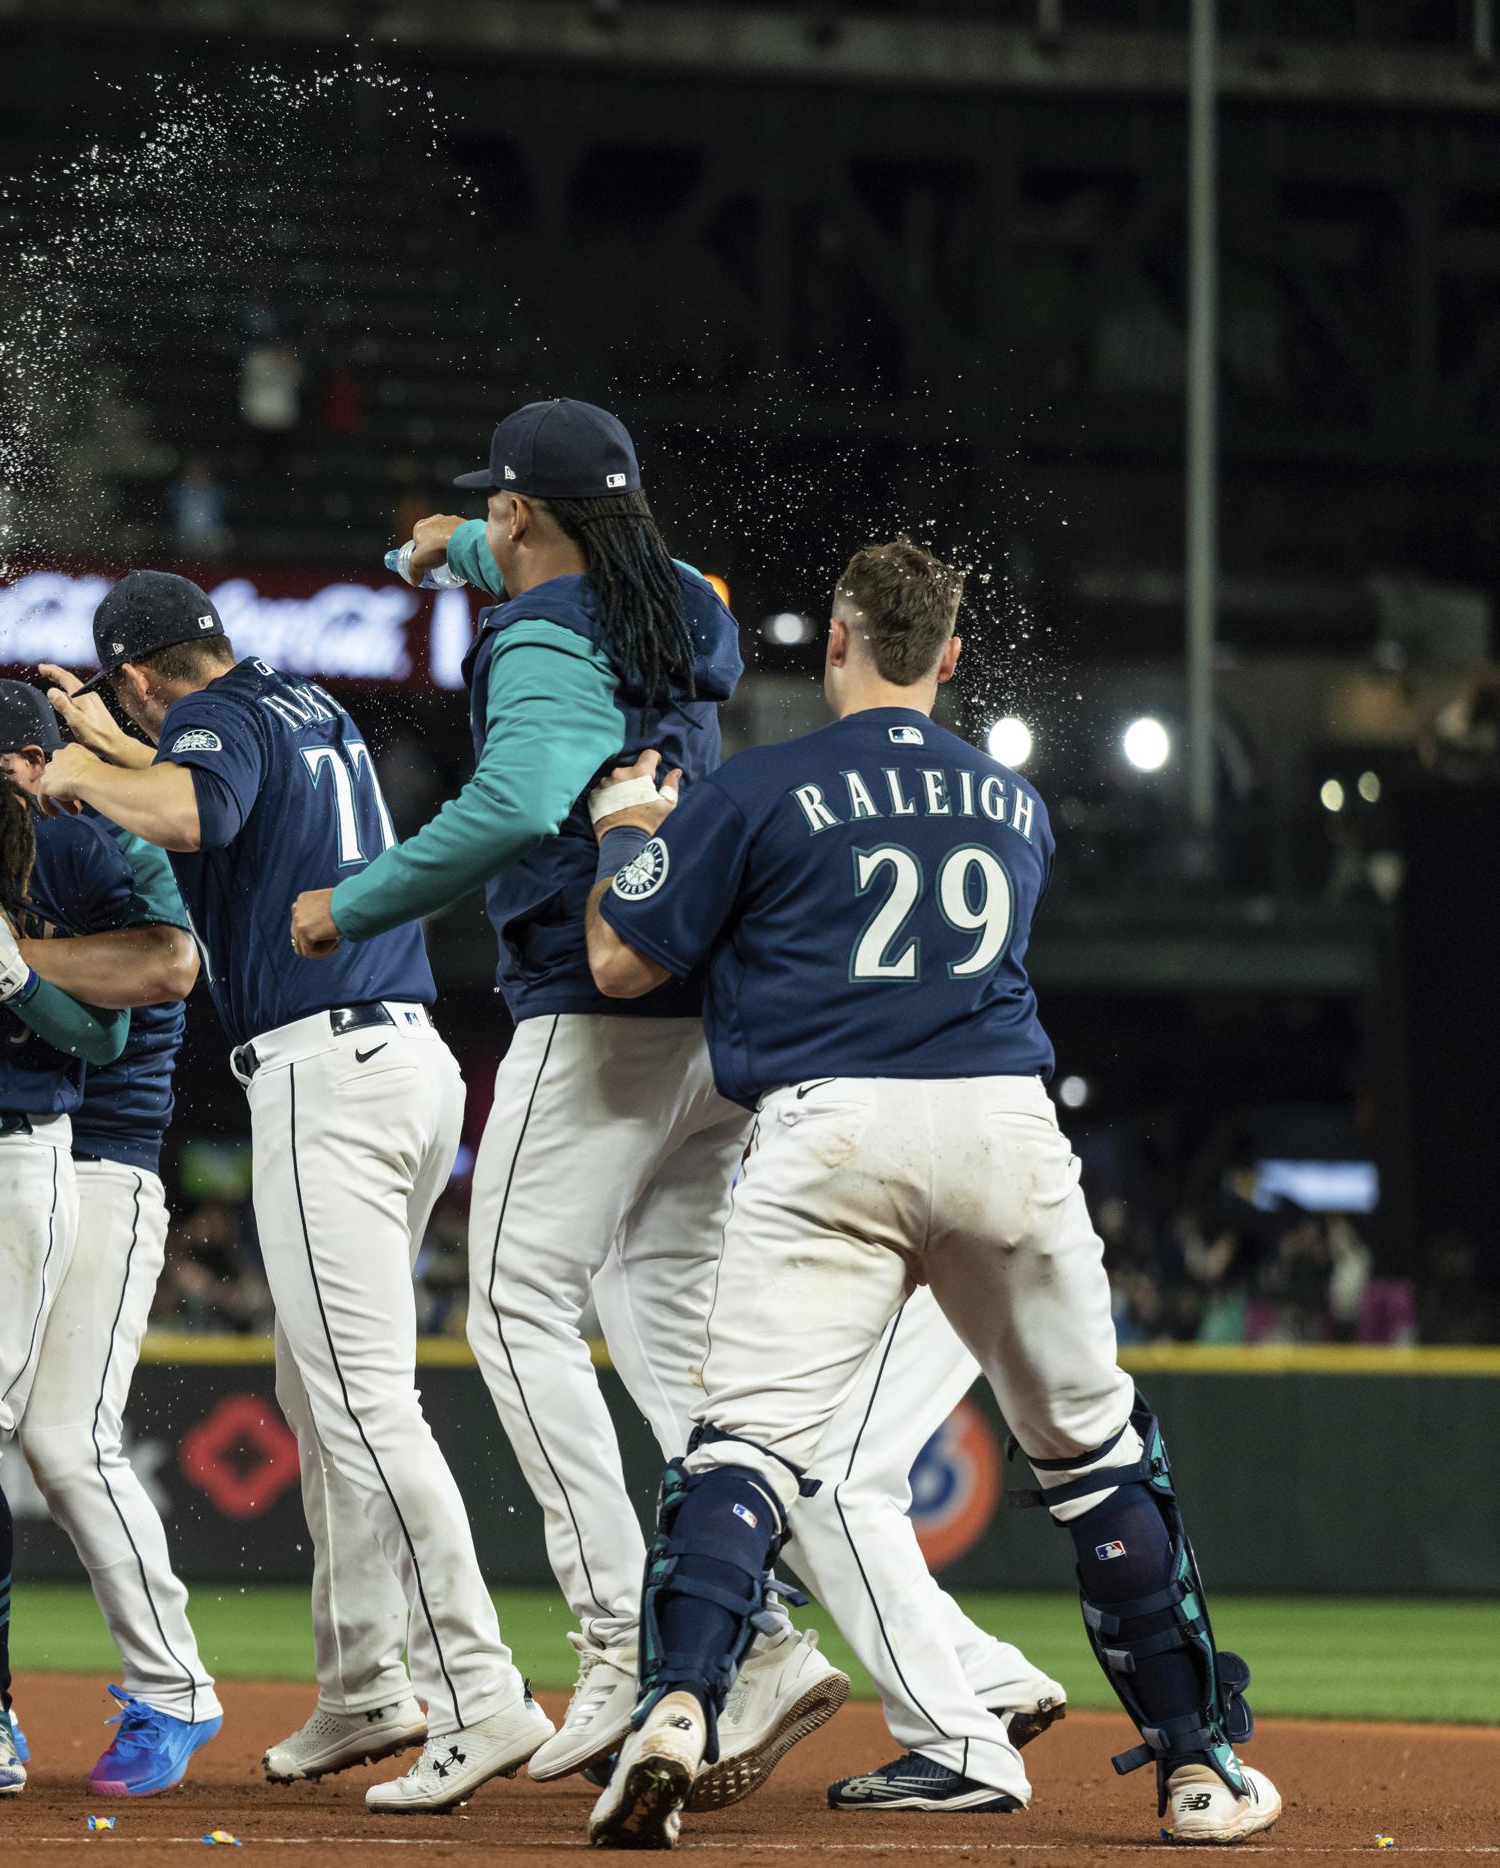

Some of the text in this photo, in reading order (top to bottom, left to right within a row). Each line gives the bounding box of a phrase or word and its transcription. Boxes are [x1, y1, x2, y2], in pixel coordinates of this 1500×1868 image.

[300, 739, 398, 868] 77
[789, 767, 1036, 845] RALEIGH
[849, 842, 1015, 983] 29
